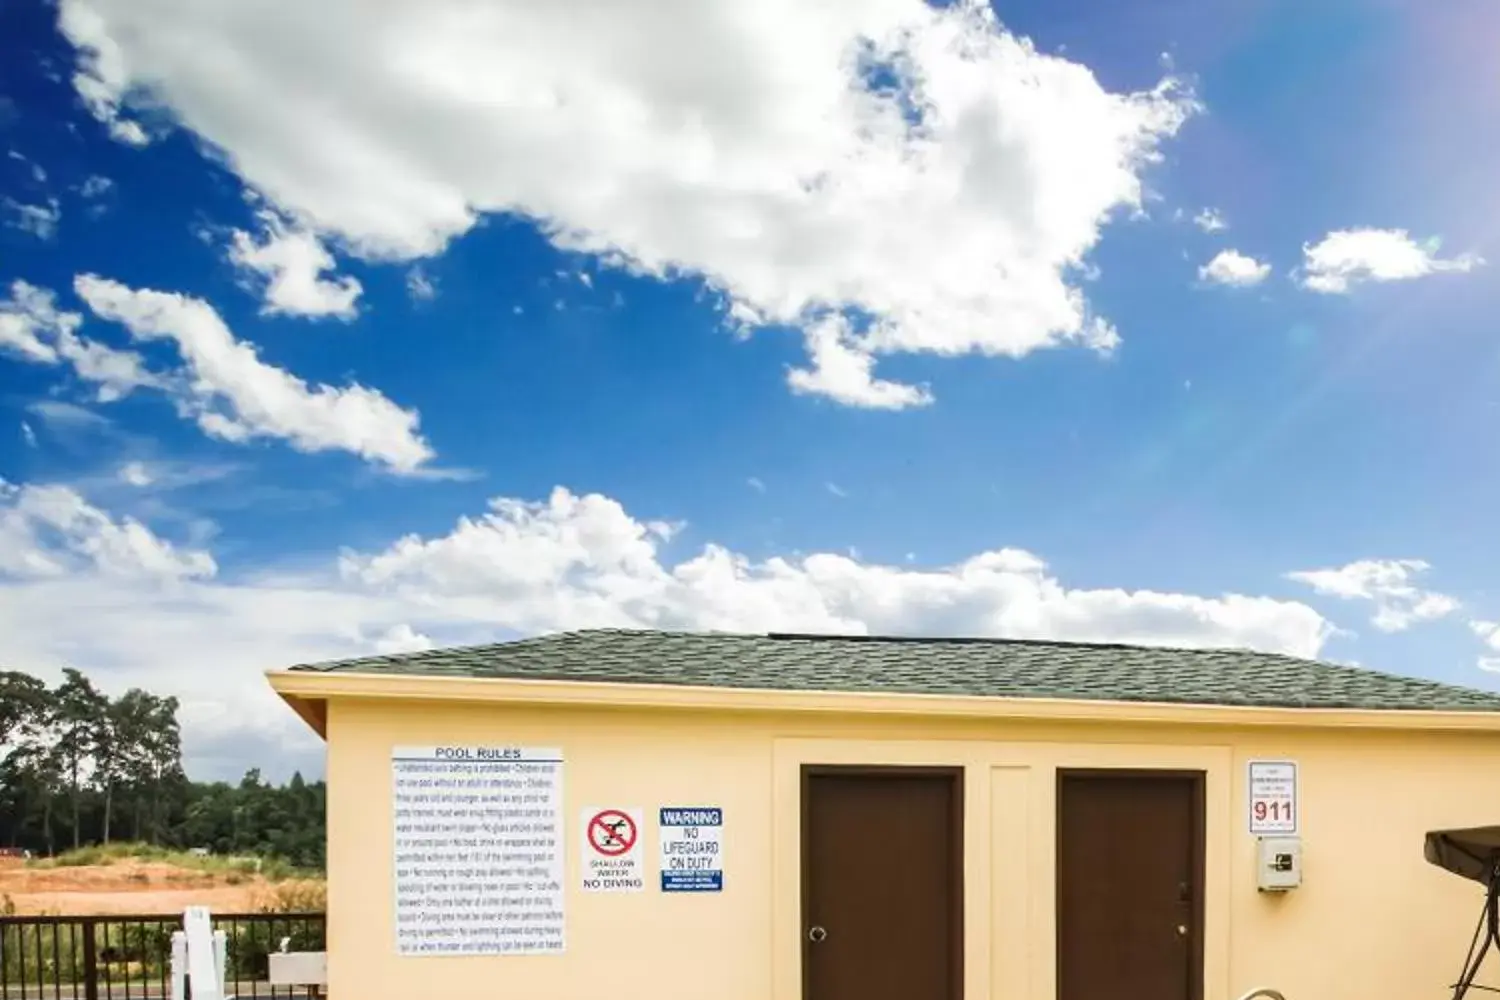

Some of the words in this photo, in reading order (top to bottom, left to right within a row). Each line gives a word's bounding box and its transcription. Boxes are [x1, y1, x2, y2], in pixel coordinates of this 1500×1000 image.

[435, 748, 472, 758] POOL
[478, 748, 521, 758] RULES
[1254, 801, 1291, 821] 911
[663, 811, 719, 824] WARNING
[683, 828, 699, 839] NO
[663, 841, 718, 855] LIFEGUARD
[590, 860, 635, 868] SHALLOW
[670, 857, 685, 869] ON
[687, 857, 713, 869] DUTY
[597, 869, 629, 877] WATER
[583, 879, 601, 889] NO
[603, 879, 643, 889] DIVING
